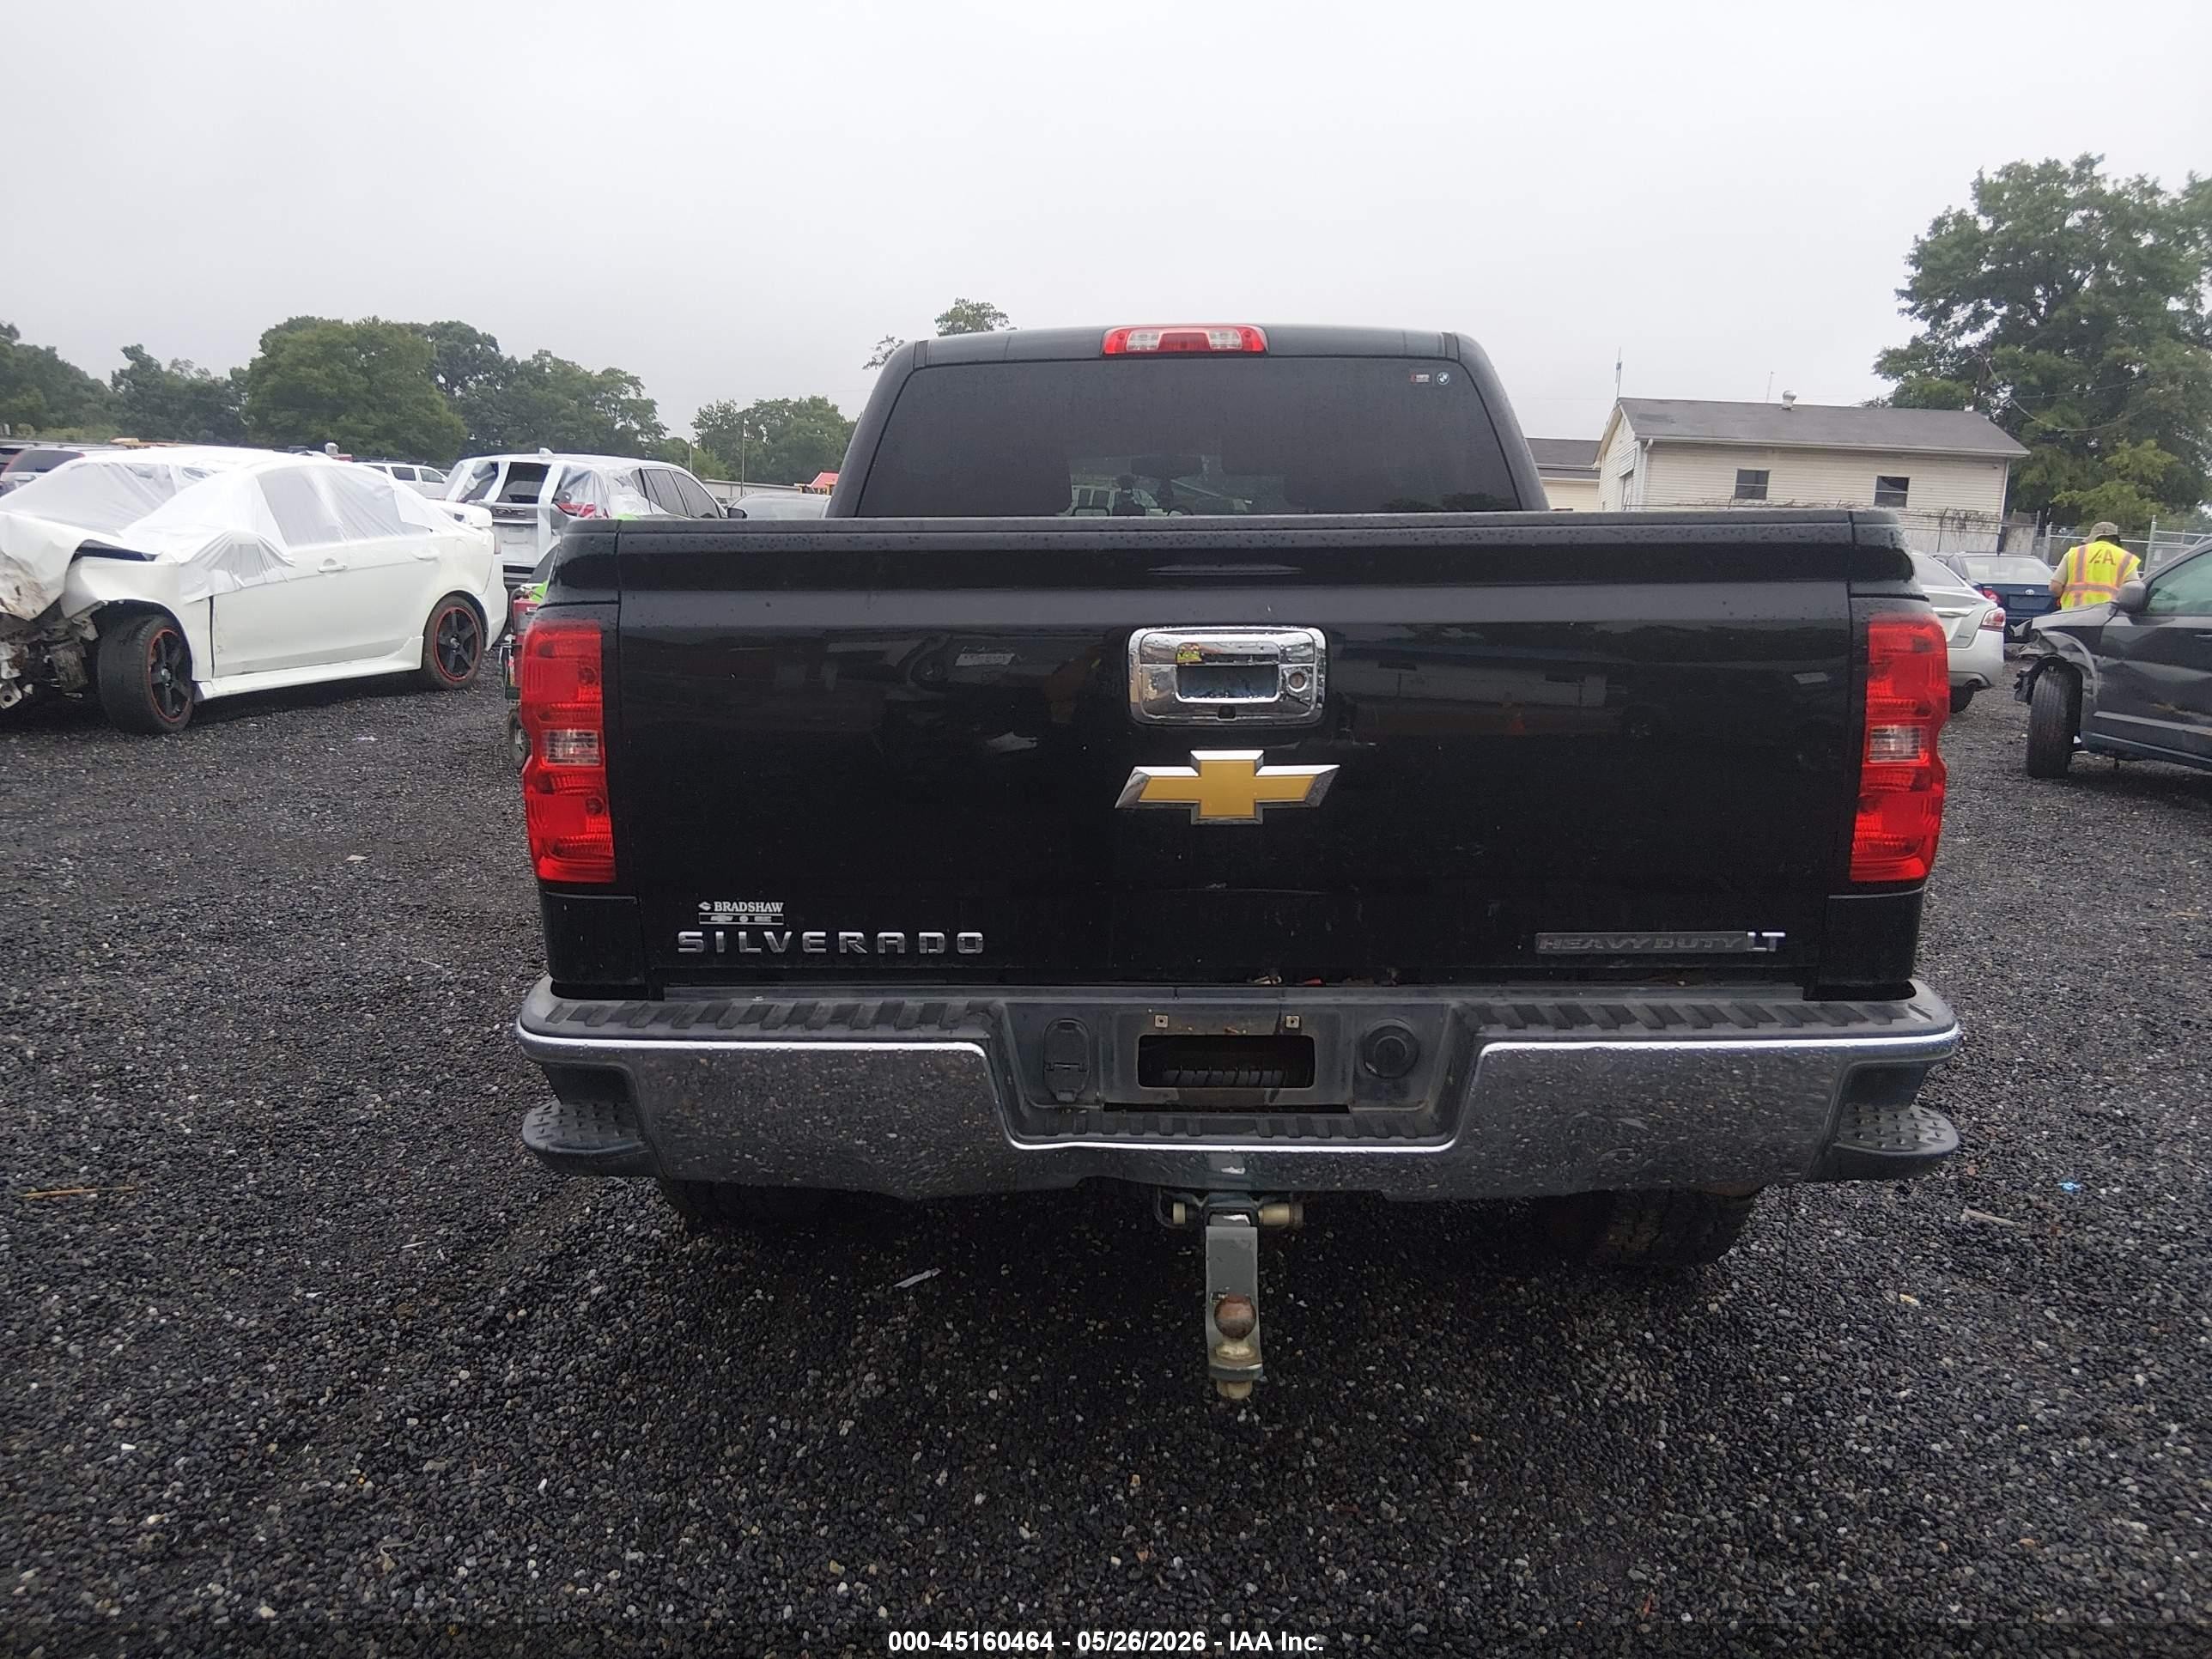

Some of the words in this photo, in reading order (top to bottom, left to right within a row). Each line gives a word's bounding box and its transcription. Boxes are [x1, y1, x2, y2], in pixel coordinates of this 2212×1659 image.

[714, 901, 784, 913] BRADSHAW
[678, 931, 984, 954] SILVERADO
[1538, 937, 1650, 950] HEAVY
[1652, 936, 1742, 949] DUTY
[1747, 932, 1786, 952] LT
